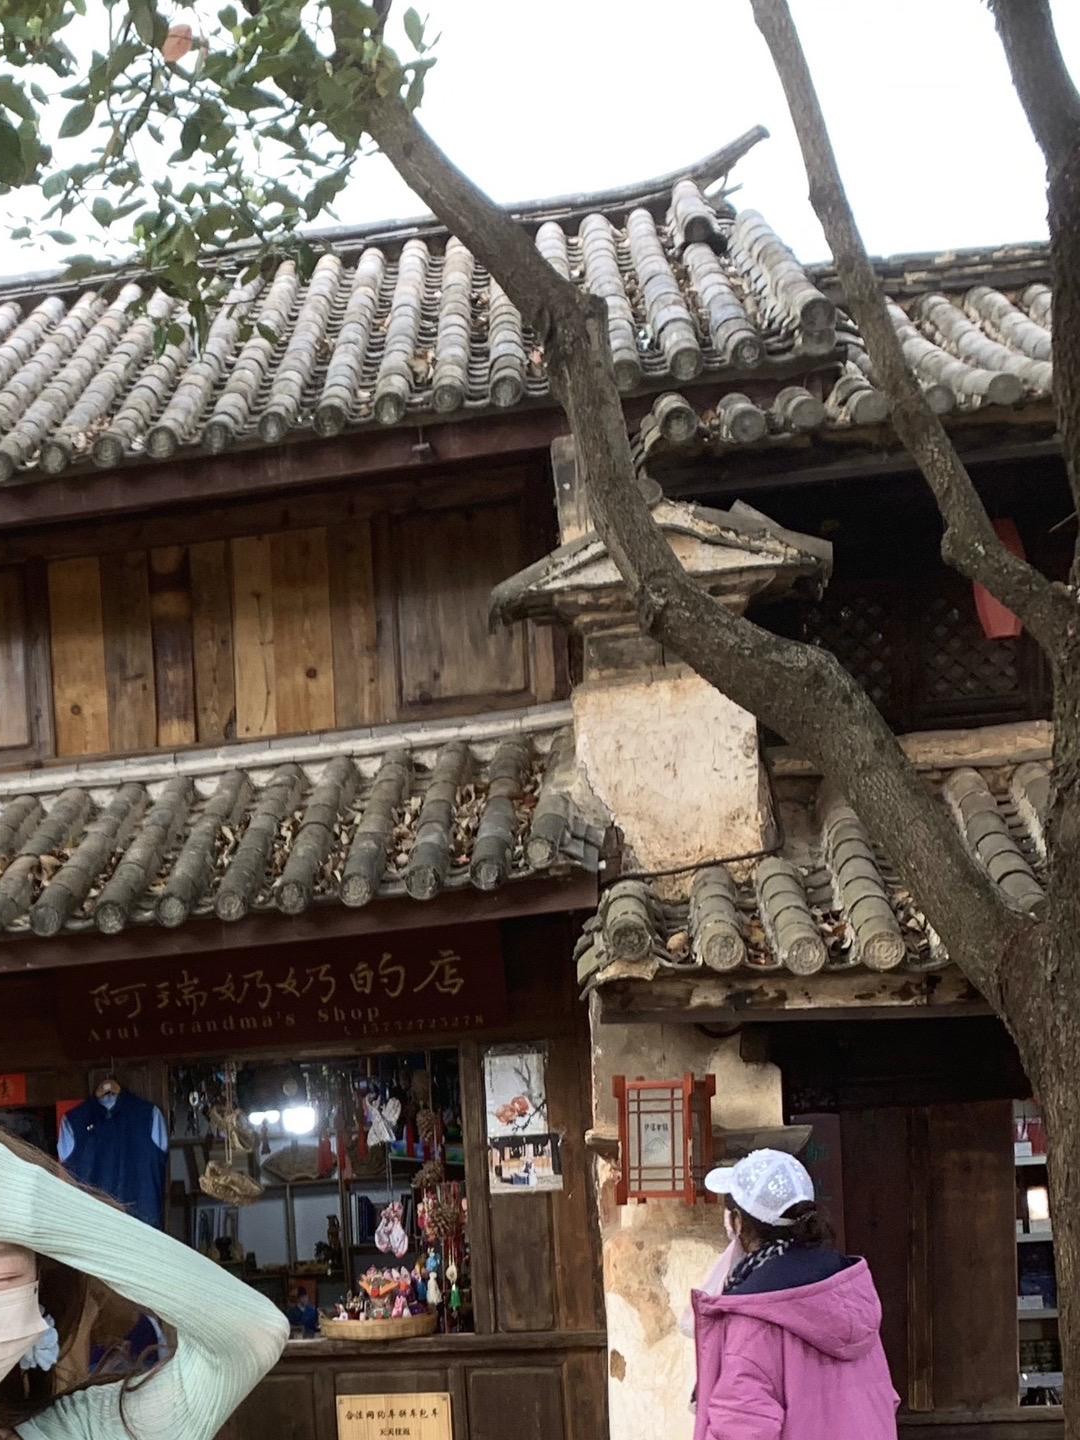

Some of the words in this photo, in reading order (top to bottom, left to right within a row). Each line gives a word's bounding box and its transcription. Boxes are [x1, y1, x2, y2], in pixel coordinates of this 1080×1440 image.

[88, 948, 466, 1019] 阿瑞奶奶的店
[87, 1022, 141, 1043] Arui
[159, 1009, 296, 1038] Grandma's
